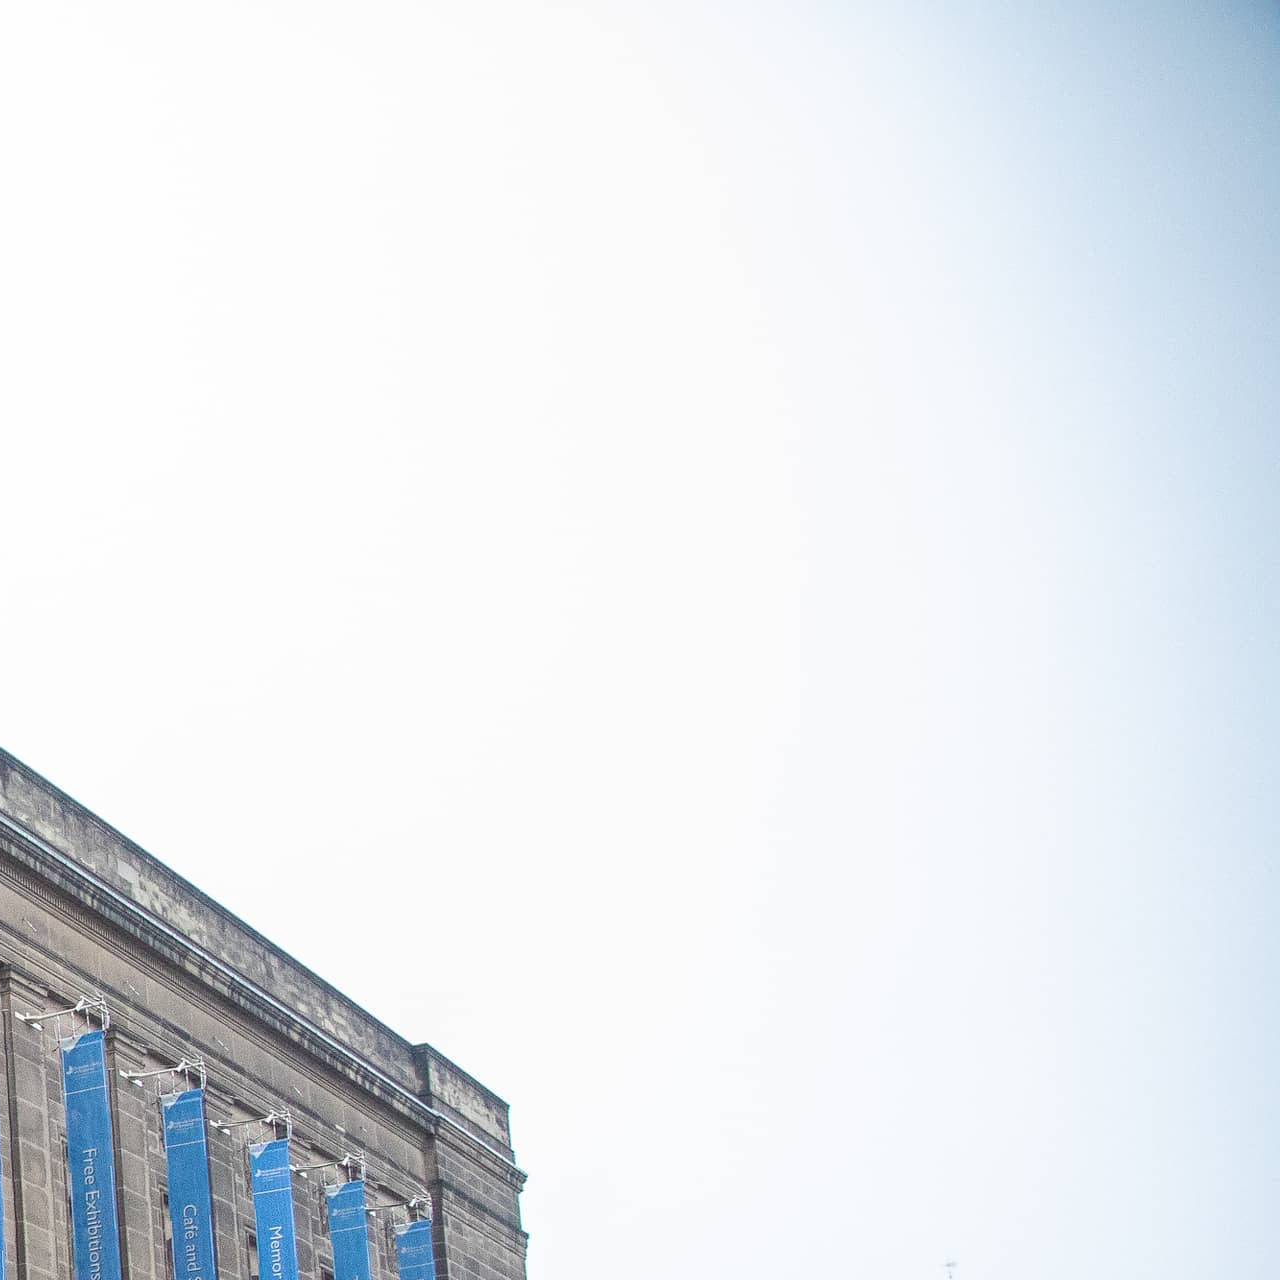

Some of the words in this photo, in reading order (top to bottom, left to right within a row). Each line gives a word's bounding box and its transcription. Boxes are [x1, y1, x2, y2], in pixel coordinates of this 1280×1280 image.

[82, 1148, 97, 1185] Free
[85, 1190, 102, 1280] Exhibitions
[183, 1204, 197, 1240] Café
[184, 1242, 200, 1273] and
